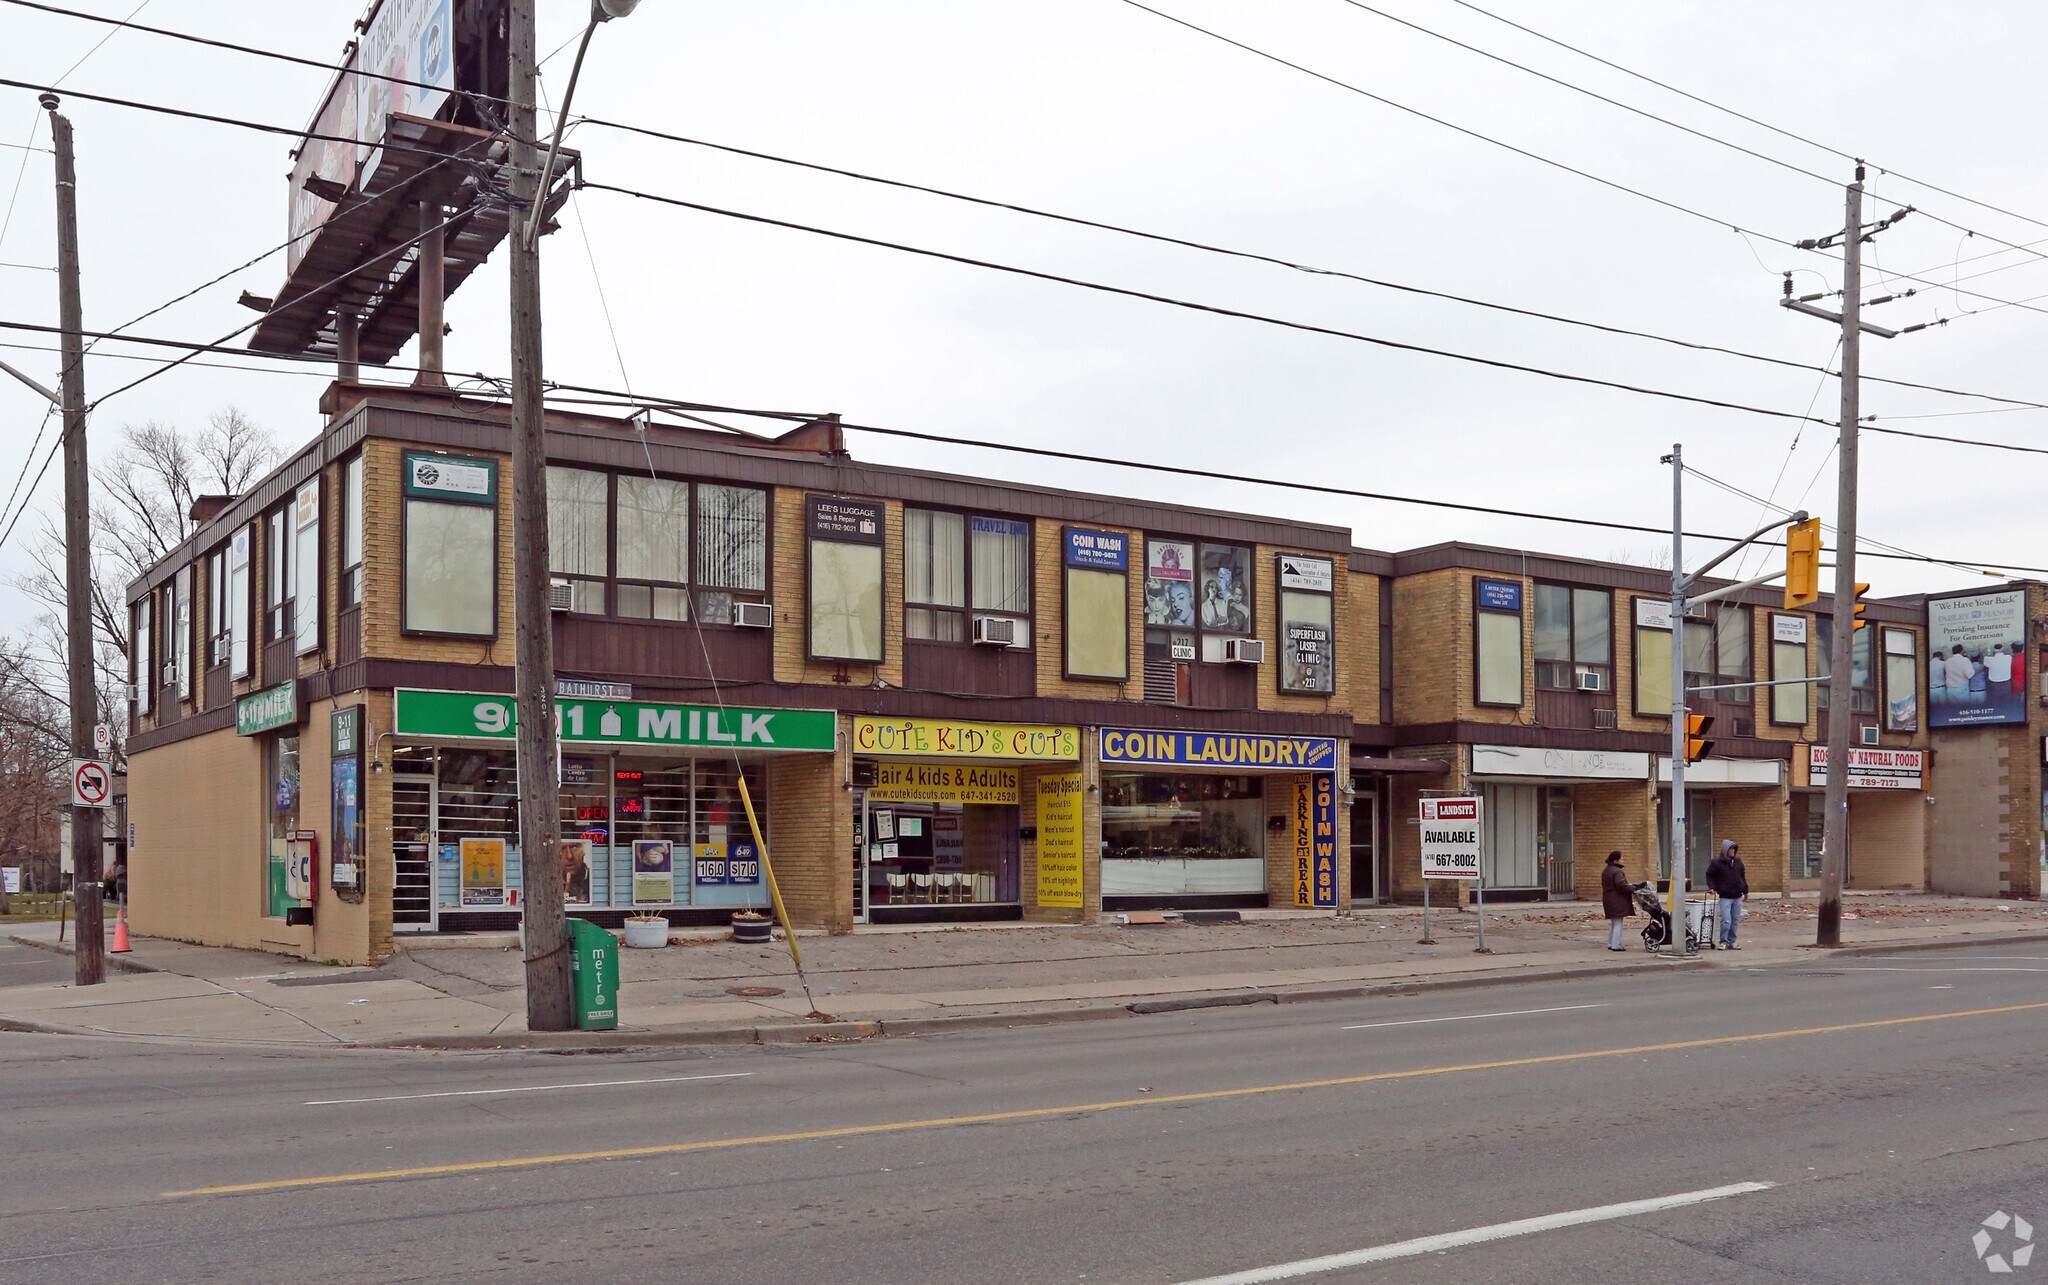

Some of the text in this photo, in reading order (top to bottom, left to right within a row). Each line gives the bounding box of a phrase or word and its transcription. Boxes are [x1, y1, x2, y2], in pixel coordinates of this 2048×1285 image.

[817, 503, 876, 518] LEE'S LUGGAGE
[818, 512, 832, 521] Sales
[839, 515, 856, 523] Repair
[972, 518, 1007, 533] TRAVEL
[1072, 534, 1122, 552] COIN WASH
[1077, 548, 1091, 557] (416)
[1953, 601, 1973, 609] Have
[1975, 598, 1993, 607] Your
[1290, 629, 1326, 641] SUPERFLASH
[1943, 623, 2011, 634] Providing Insurance
[1963, 633, 2004, 641] Generations
[1173, 647, 1192, 658] CLINIC
[1300, 641, 1317, 652] LASER
[1296, 652, 1320, 664] CLINIC
[559, 681, 614, 697] BATHURST
[338, 714, 351, 729] 9-11
[637, 708, 776, 743] MILK
[338, 728, 351, 740] MILK
[859, 721, 1075, 756] CUTE KID'S CUTS
[1104, 732, 1310, 765] COIN LAUNDRY
[1858, 751, 1893, 766] NATURAL
[1895, 753, 1919, 767] FOODS
[876, 766, 1016, 789] air 4 kids & Adults
[1860, 778, 1899, 787] 789-7173
[1038, 775, 1082, 798] Tuesday Special
[869, 788, 1016, 802] www.cutekidscuts.com 647-341-2520
[577, 807, 609, 819] OPEN
[1297, 784, 1310, 847] PARKING
[1439, 805, 1474, 815] LANDSITE
[1045, 813, 1057, 821] Kid's
[1045, 838, 1057, 846] Dad's
[1316, 777, 1333, 901] COIN WASH
[1424, 830, 1476, 843] AVAILABLE
[1043, 851, 1060, 859] Senior's
[1436, 853, 1476, 867] 667-8002
[1297, 858, 1310, 904] REAR
